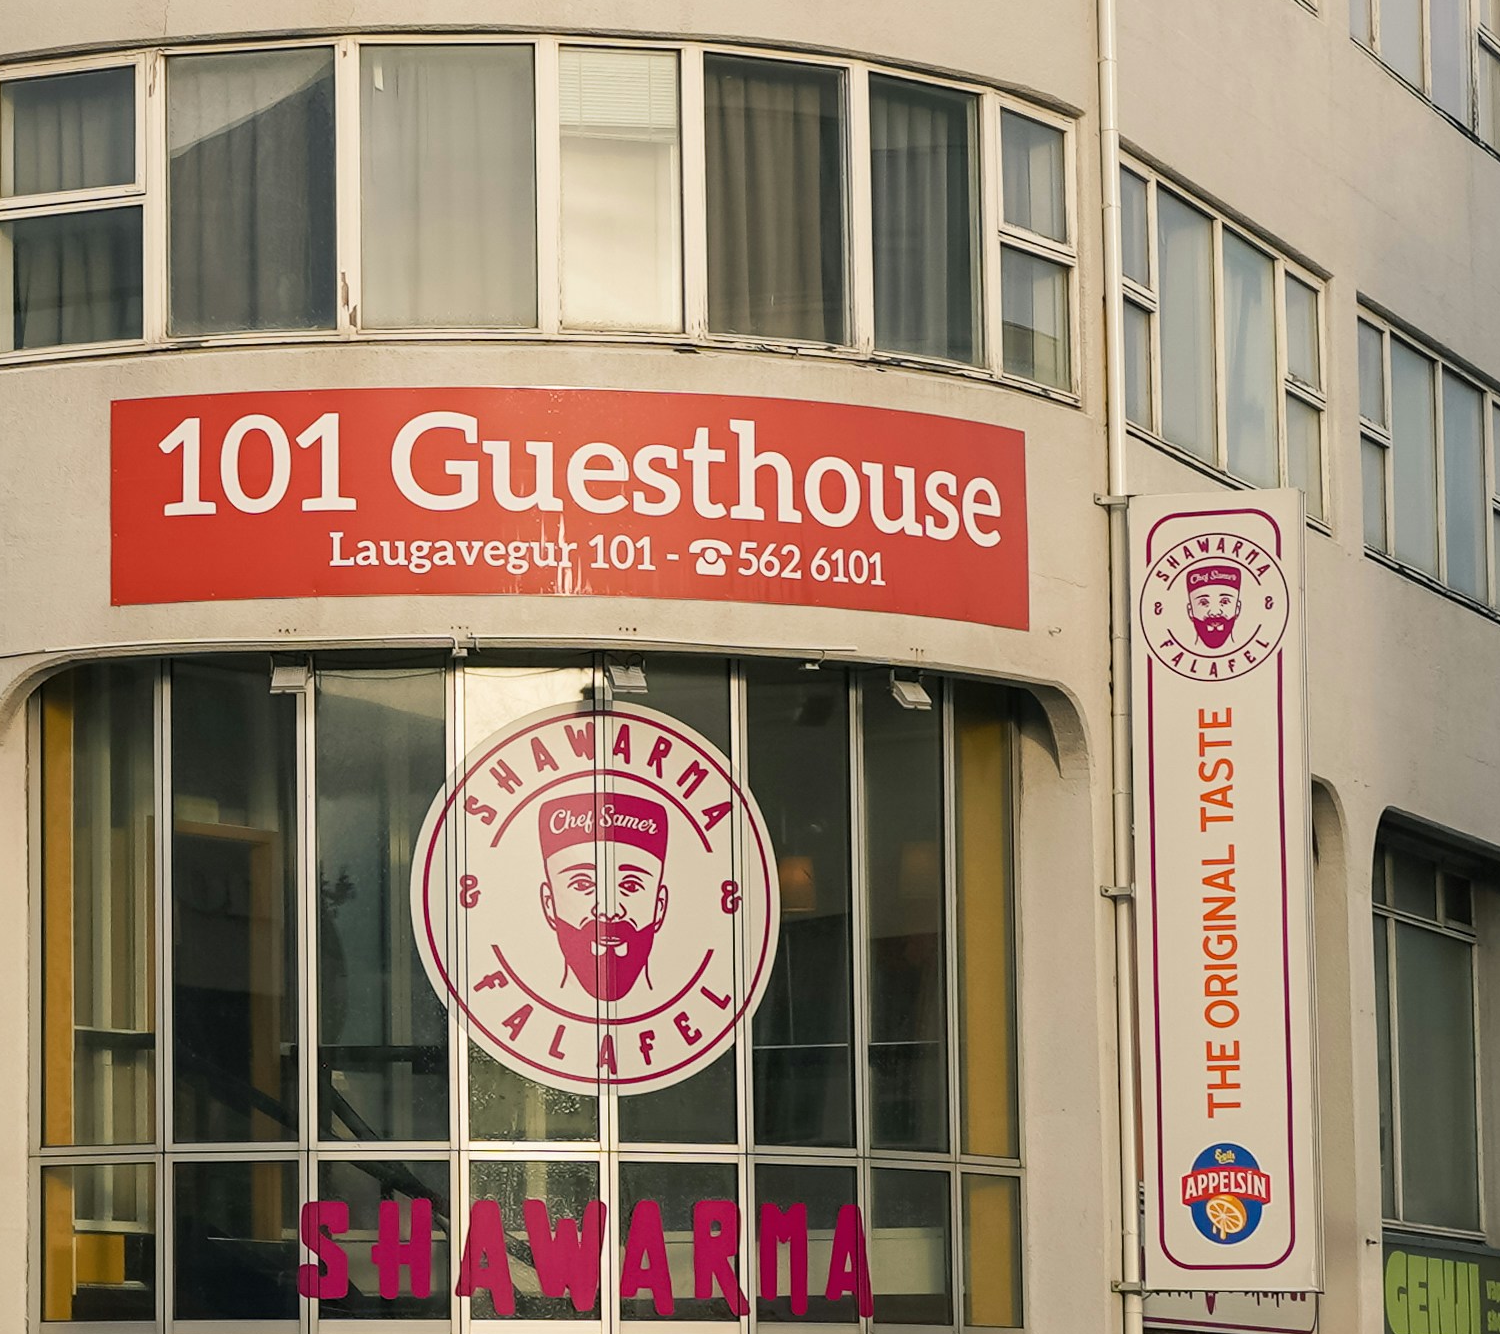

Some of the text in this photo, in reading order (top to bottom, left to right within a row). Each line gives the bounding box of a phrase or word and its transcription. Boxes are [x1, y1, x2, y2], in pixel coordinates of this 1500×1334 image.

[158, 410, 1002, 548] 101 Guesthouse
[329, 531, 573, 573] Laugavegur
[589, 533, 657, 571] 101
[738, 541, 802, 580] 562
[810, 546, 886, 587] 6101
[1155, 537, 1271, 583] SHAWARMA
[1159, 639, 1270, 679] FALAFEL
[463, 722, 735, 831] SHAWARMA
[549, 803, 659, 835] Chef Samer
[1197, 706, 1242, 1119] THE ORIGINAL TASTE
[473, 970, 732, 1075] FALAFEL
[1185, 1170, 1267, 1200] APPELSÍN
[297, 1198, 875, 1318] SHAWARMA
